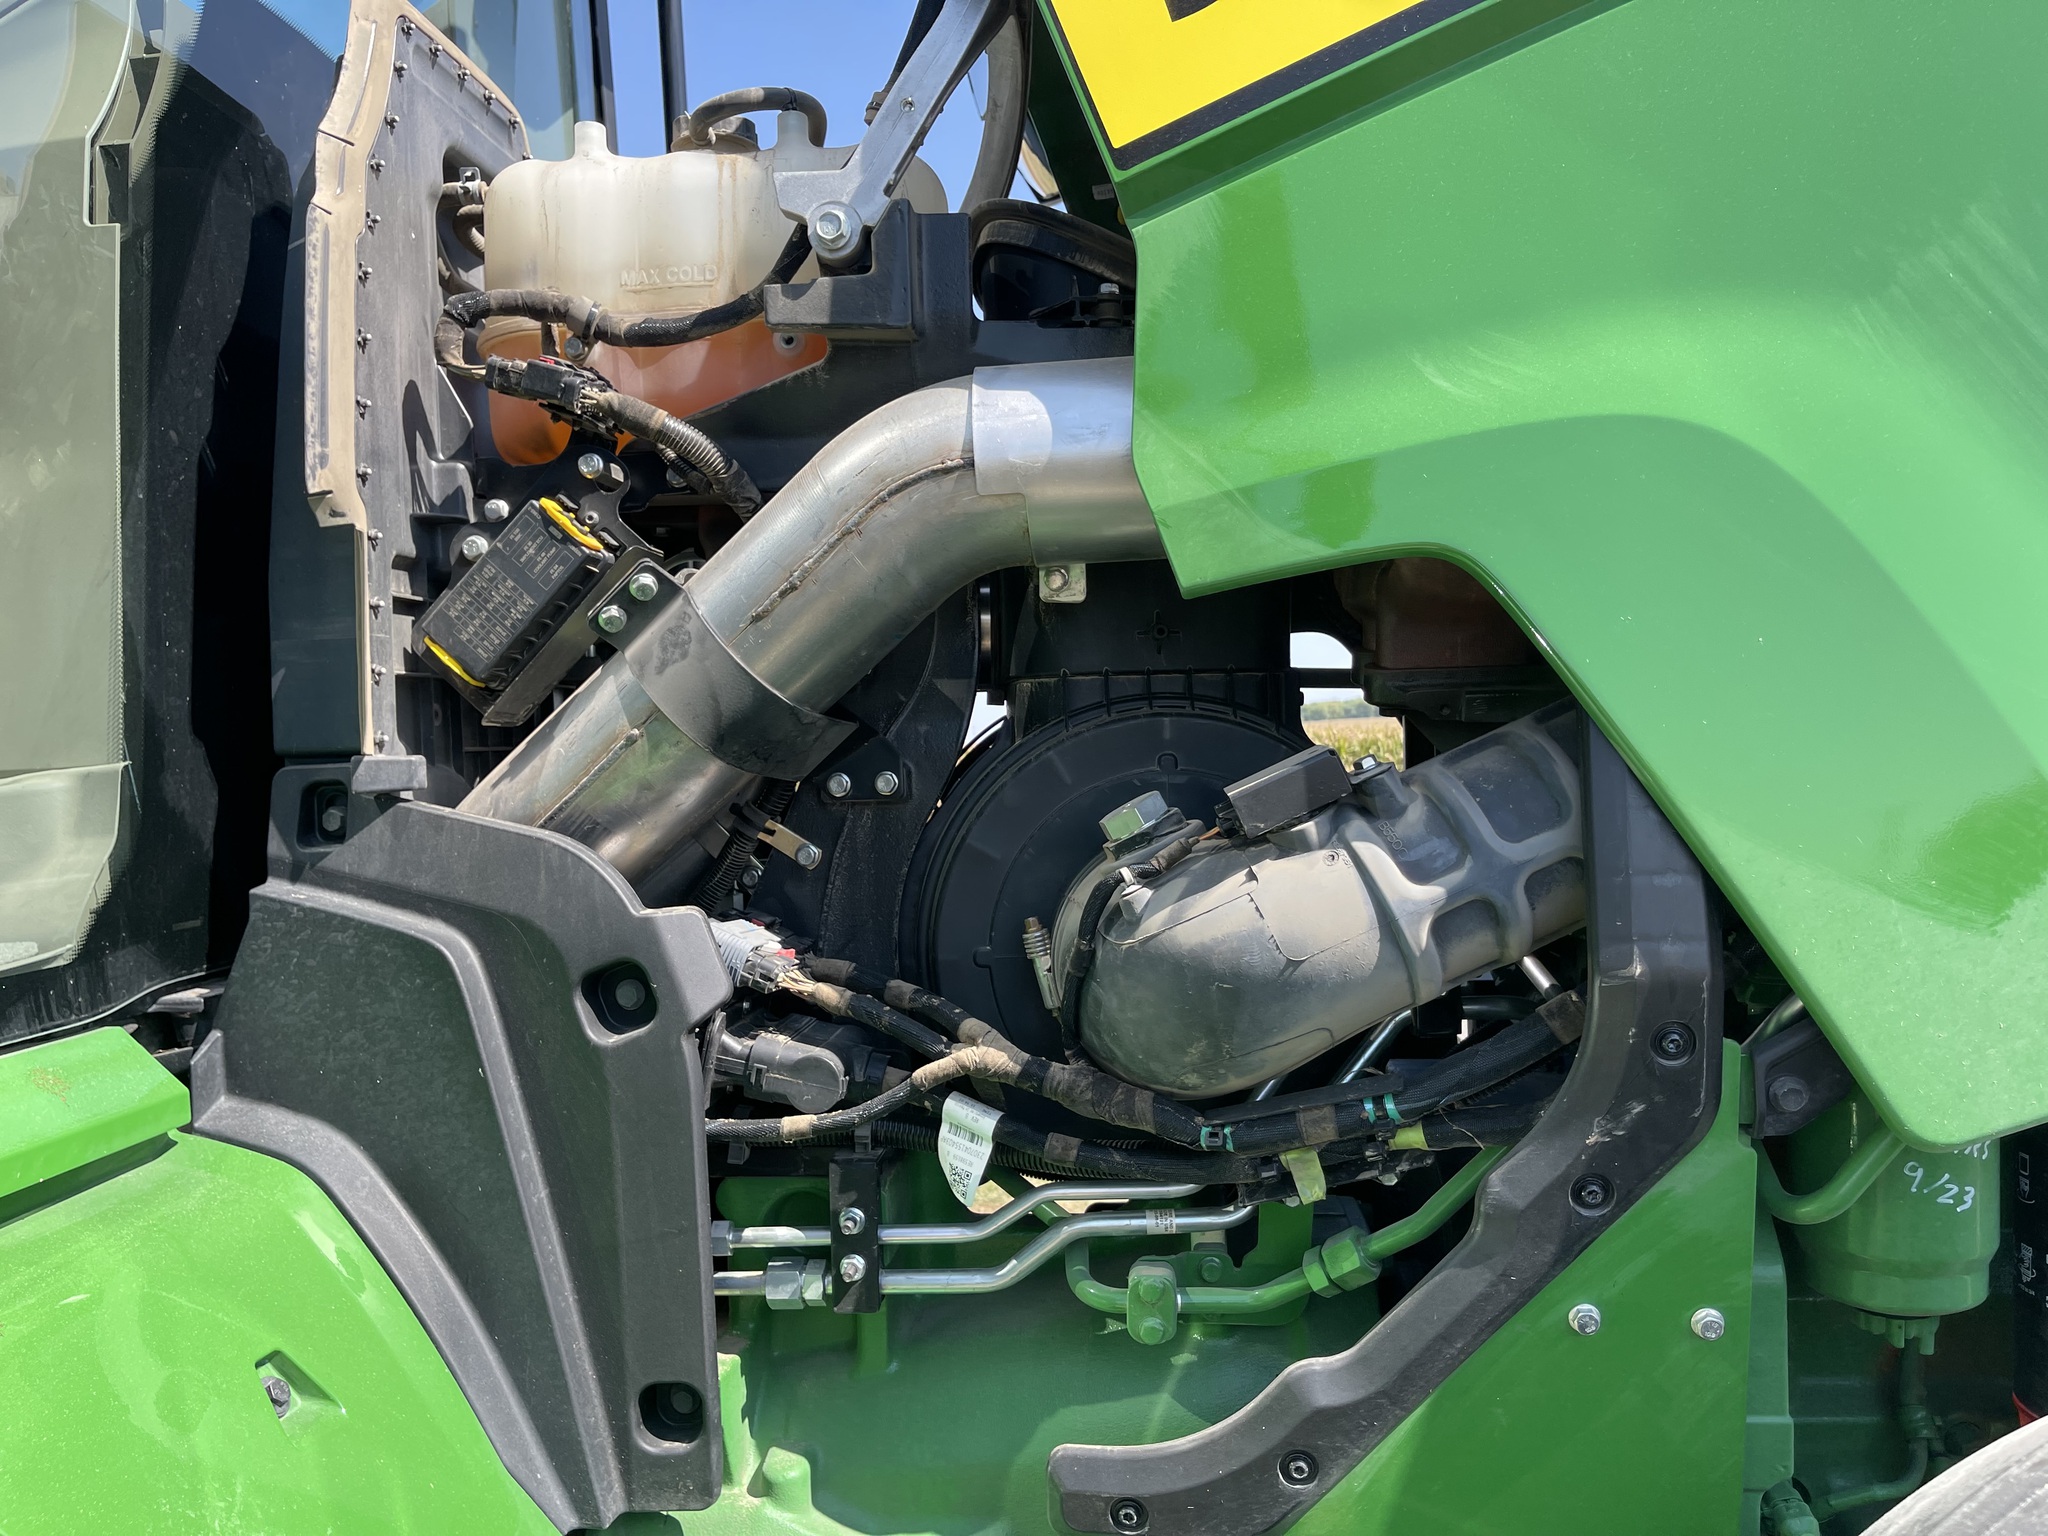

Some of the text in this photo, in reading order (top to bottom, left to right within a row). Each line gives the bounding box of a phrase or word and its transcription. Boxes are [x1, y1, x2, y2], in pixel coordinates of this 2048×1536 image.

[620, 263, 718, 285] MAX COLD
[533, 556, 548, 573] COOLANT
[546, 546, 557, 558] PUMP
[1903, 1161, 1975, 1213] 9/23
